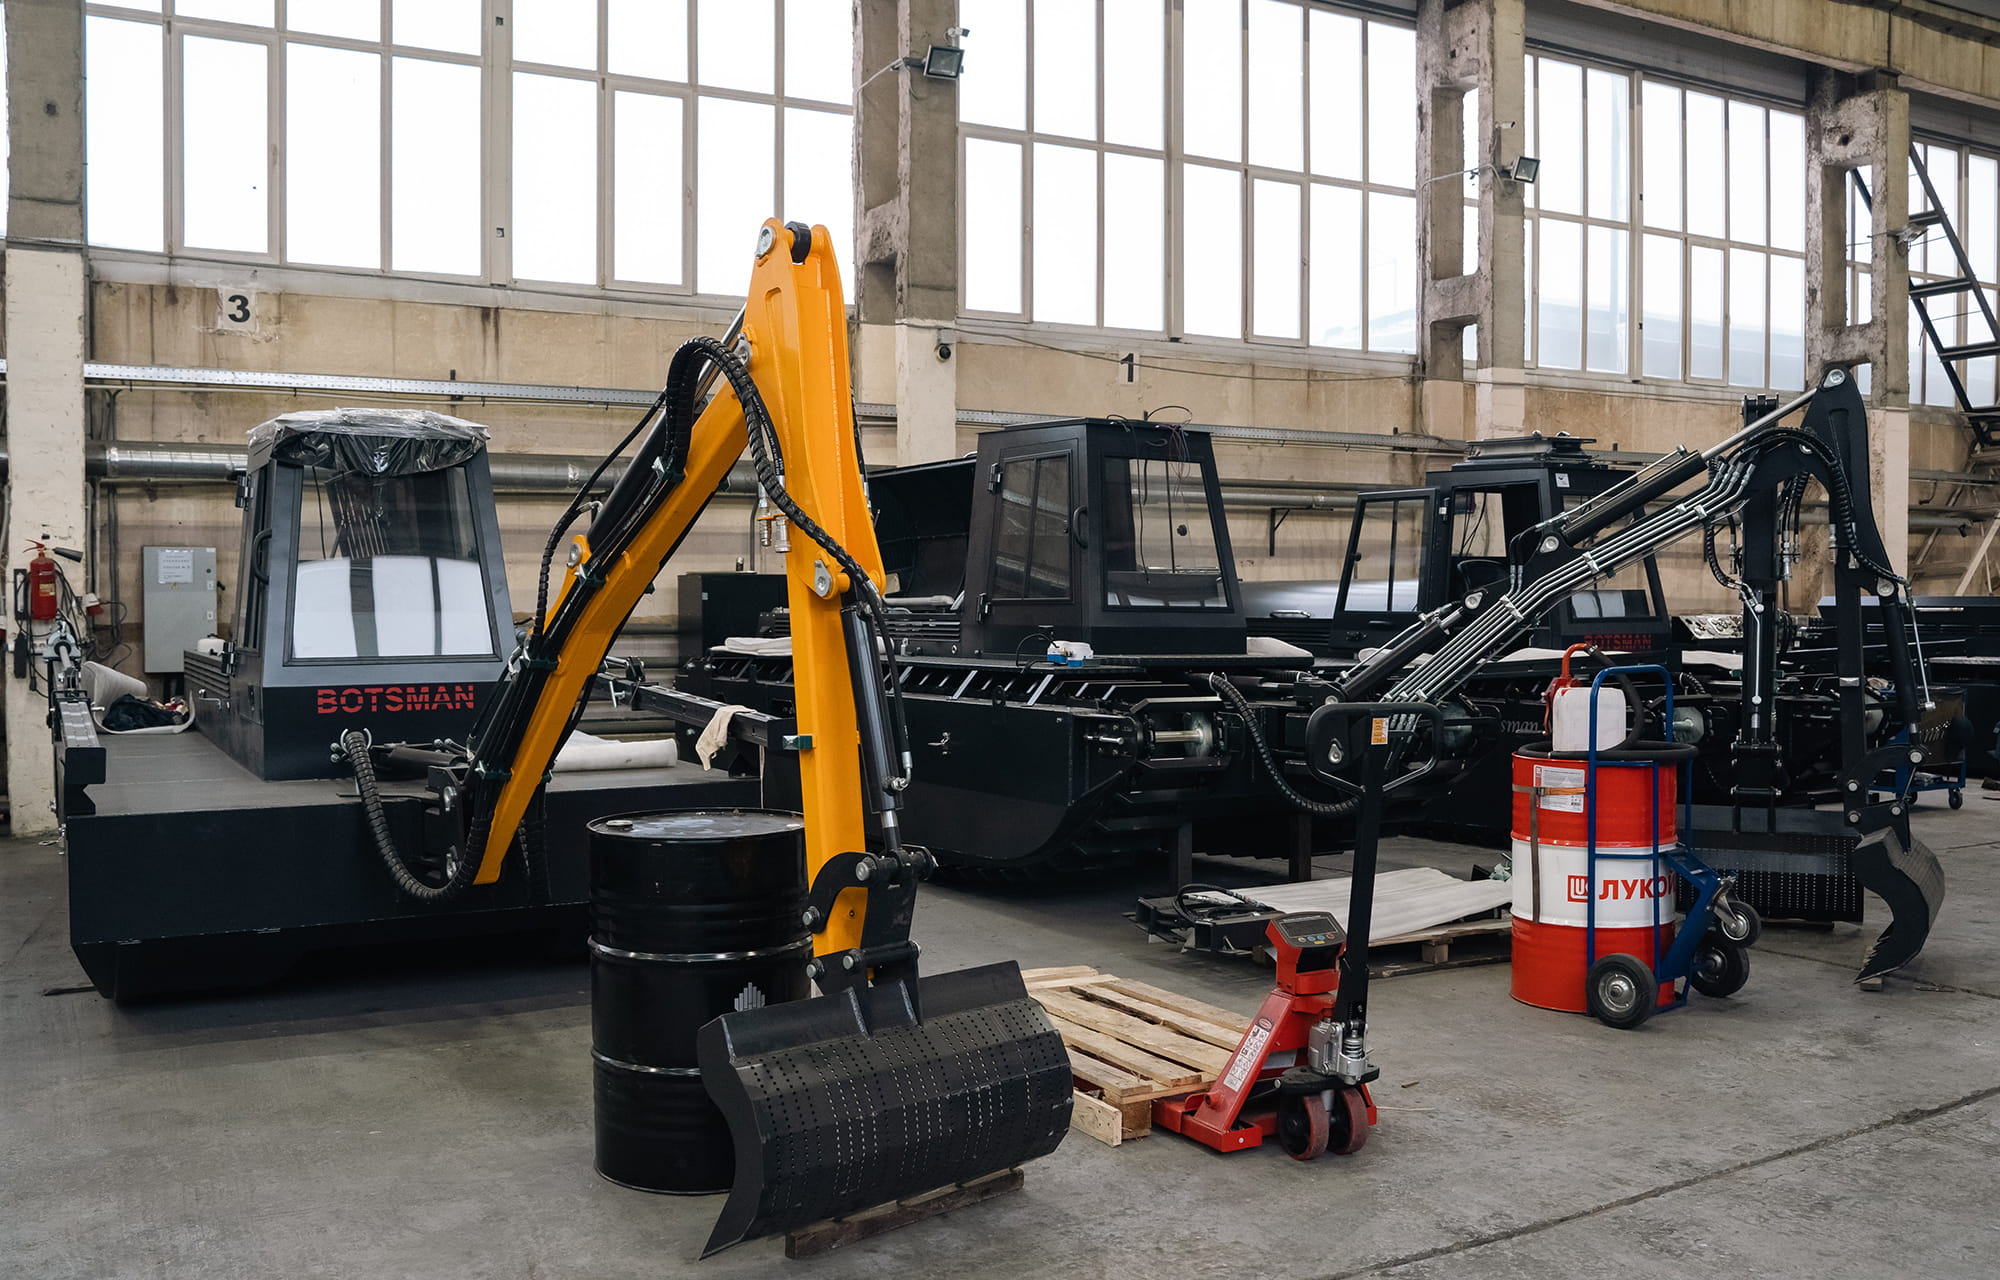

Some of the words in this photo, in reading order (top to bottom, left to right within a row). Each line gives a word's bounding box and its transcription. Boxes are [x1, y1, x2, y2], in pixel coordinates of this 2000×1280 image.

[228, 294, 251, 323] 3
[1120, 353, 1134, 382] 1
[317, 685, 475, 714] BOTSMAN
